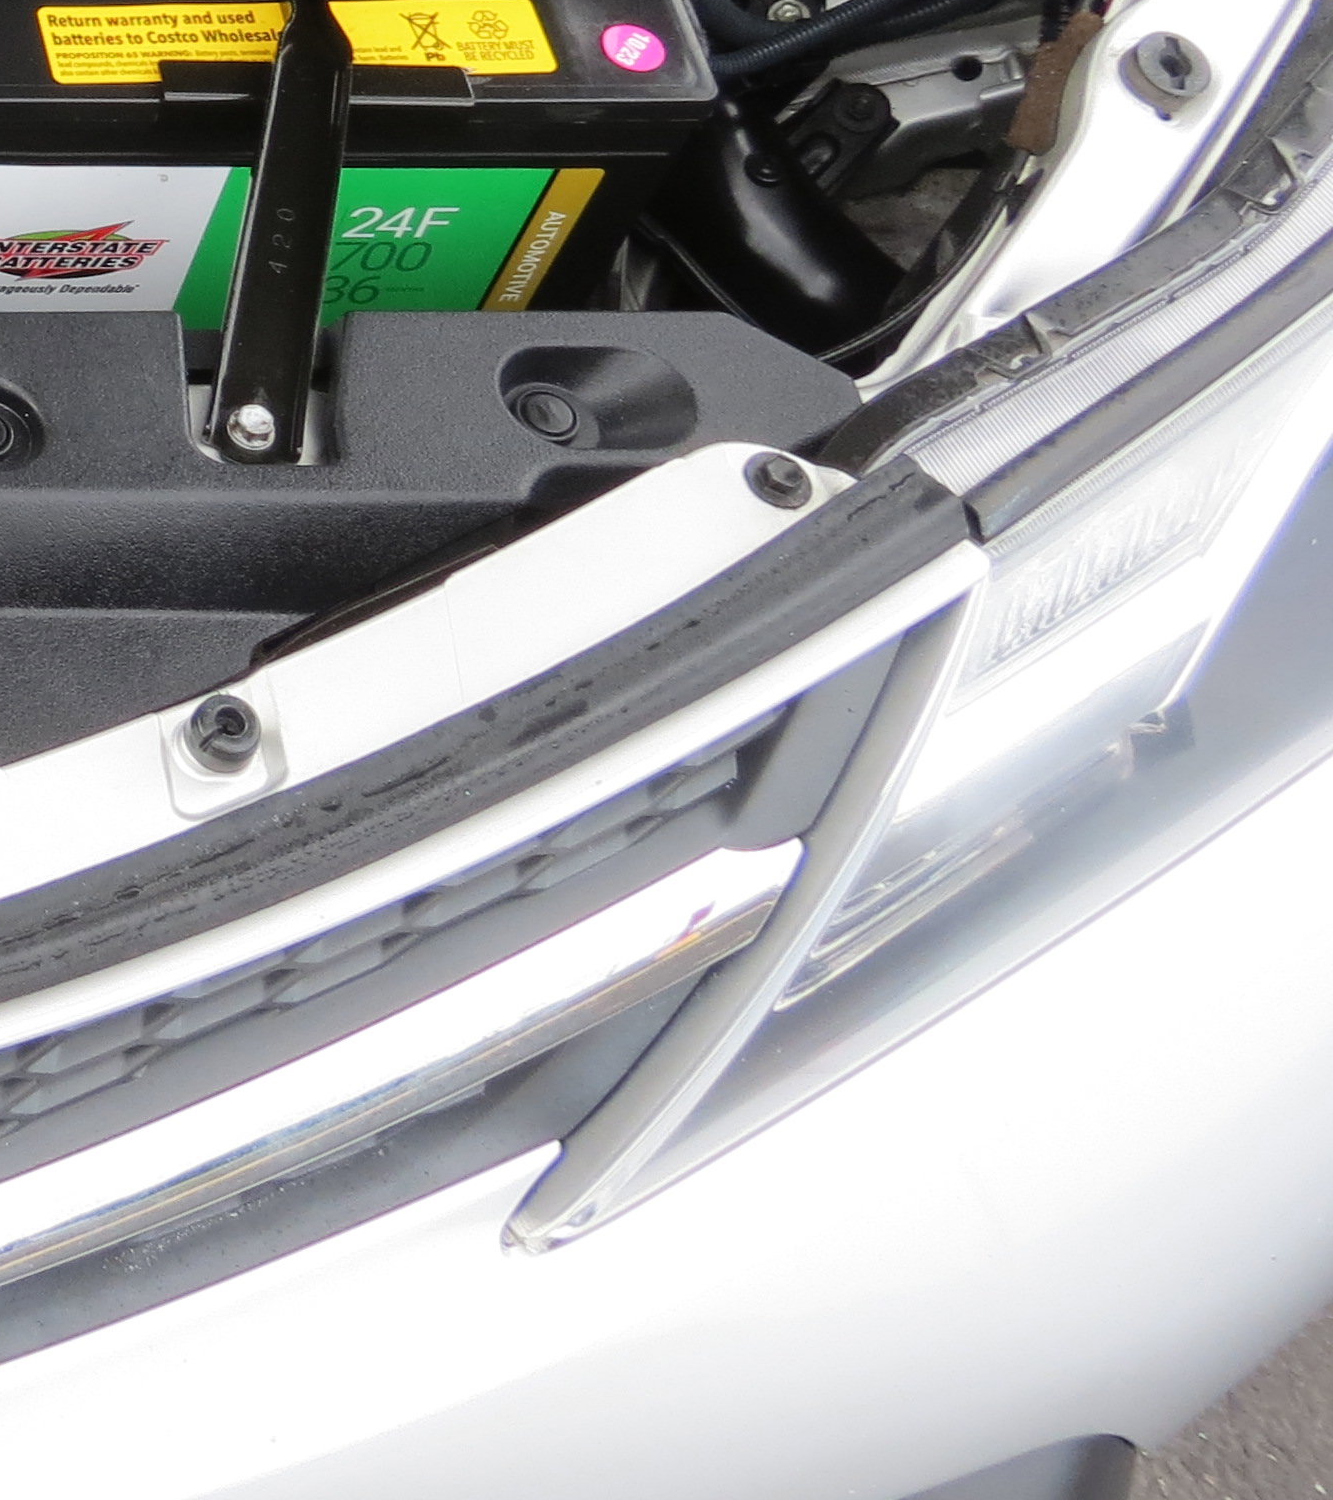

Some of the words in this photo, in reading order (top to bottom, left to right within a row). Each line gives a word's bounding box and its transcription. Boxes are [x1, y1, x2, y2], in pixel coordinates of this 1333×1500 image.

[47, 13, 102, 28] Return
[104, 13, 178, 30] warranty
[183, 11, 213, 25] and
[215, 9, 255, 24] used
[51, 32, 124, 46] batteries
[126, 33, 144, 45] to
[147, 30, 199, 44] Costco
[457, 41, 501, 52] BATTERY
[502, 40, 534, 51] MUST
[55, 52, 123, 60] PROPOSITION
[425, 51, 446, 61] Pb
[463, 51, 480, 61] BE
[481, 50, 535, 61] RECYCLED
[615, 32, 652, 67] 10/23
[341, 206, 461, 239] 24F
[331, 241, 433, 273] 700
[498, 209, 569, 303] AUTOMOTIVE
